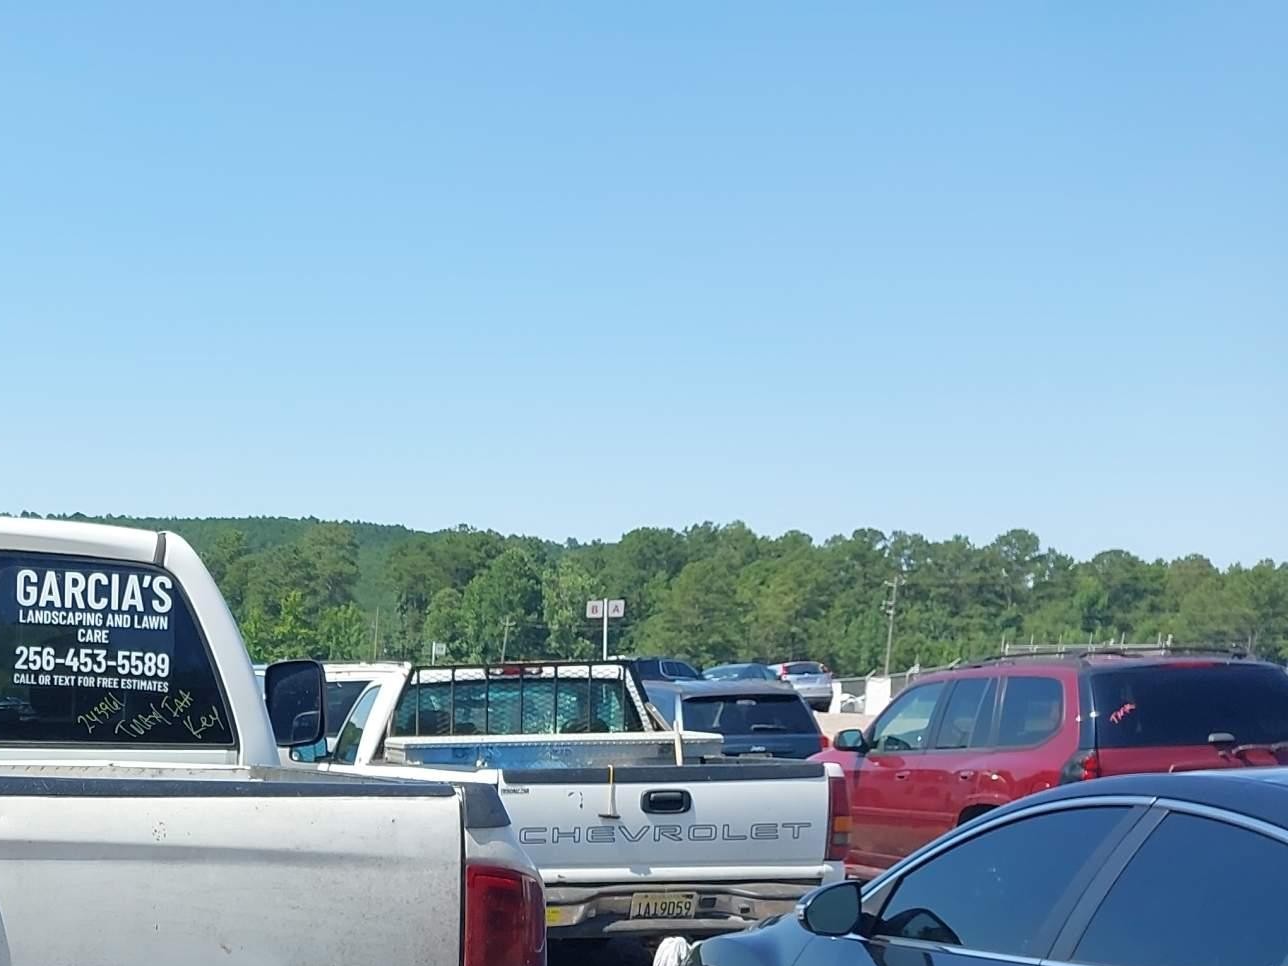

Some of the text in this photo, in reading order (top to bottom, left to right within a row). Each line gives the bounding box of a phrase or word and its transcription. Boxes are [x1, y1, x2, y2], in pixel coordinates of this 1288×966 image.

[16, 569, 173, 613] GARCIA'S
[19, 609, 168, 630] LANDSCAPING AND LAWN
[77, 629, 109, 643] CARE
[14, 646, 170, 678] 256-453-5589
[13, 673, 169, 693] CALL OR TEXT FOR FREE ESTIMATES
[518, 822, 812, 844] CHEVROLET
